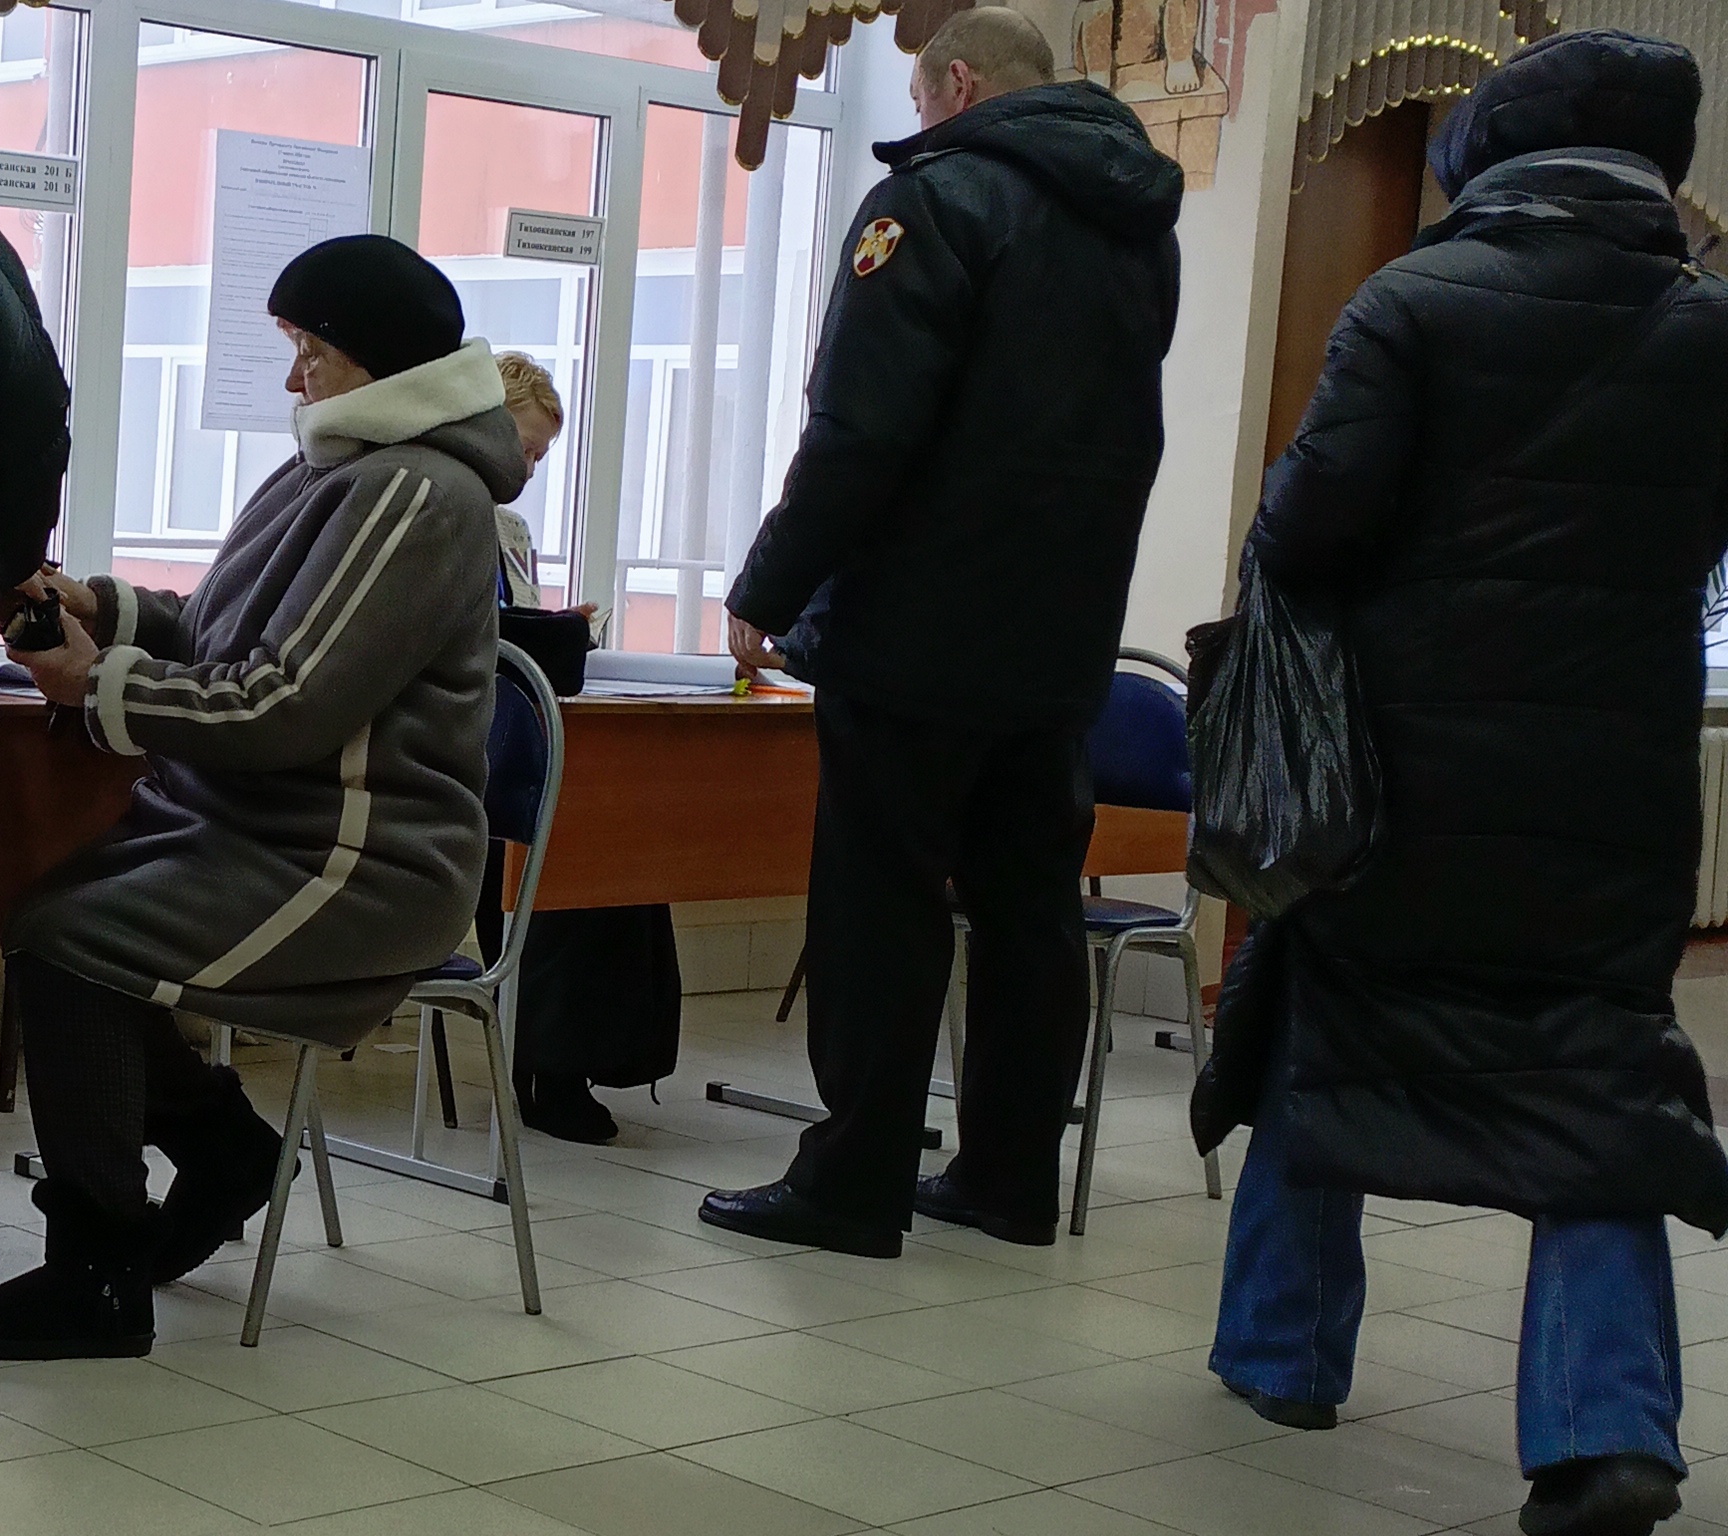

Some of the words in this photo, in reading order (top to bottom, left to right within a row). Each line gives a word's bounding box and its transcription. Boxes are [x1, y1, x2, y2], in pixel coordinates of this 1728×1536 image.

[44, 165, 59, 176] 201
[43, 180, 58, 192] 201
[581, 228, 594, 239] 197
[579, 245, 592, 255] 199
